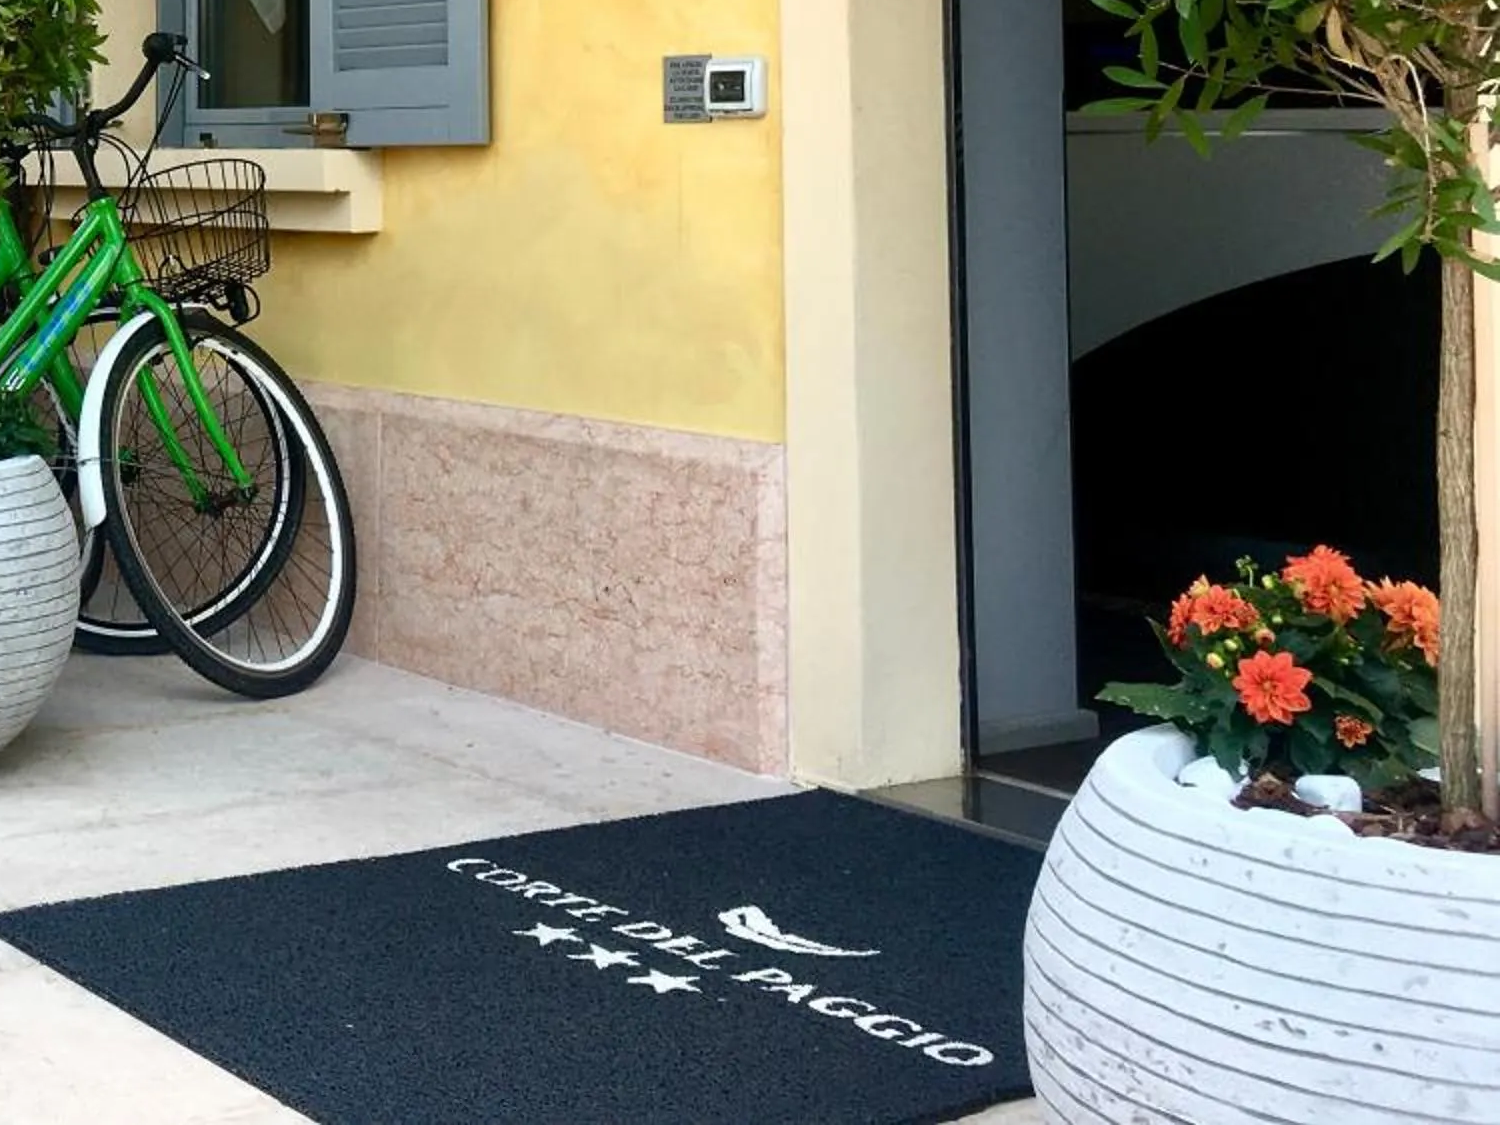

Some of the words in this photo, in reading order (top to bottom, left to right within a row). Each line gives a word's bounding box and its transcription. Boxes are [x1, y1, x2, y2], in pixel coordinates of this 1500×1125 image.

[446, 857, 629, 923] CORTE
[610, 919, 740, 969] DEL
[729, 967, 995, 1067] PAGGIO
